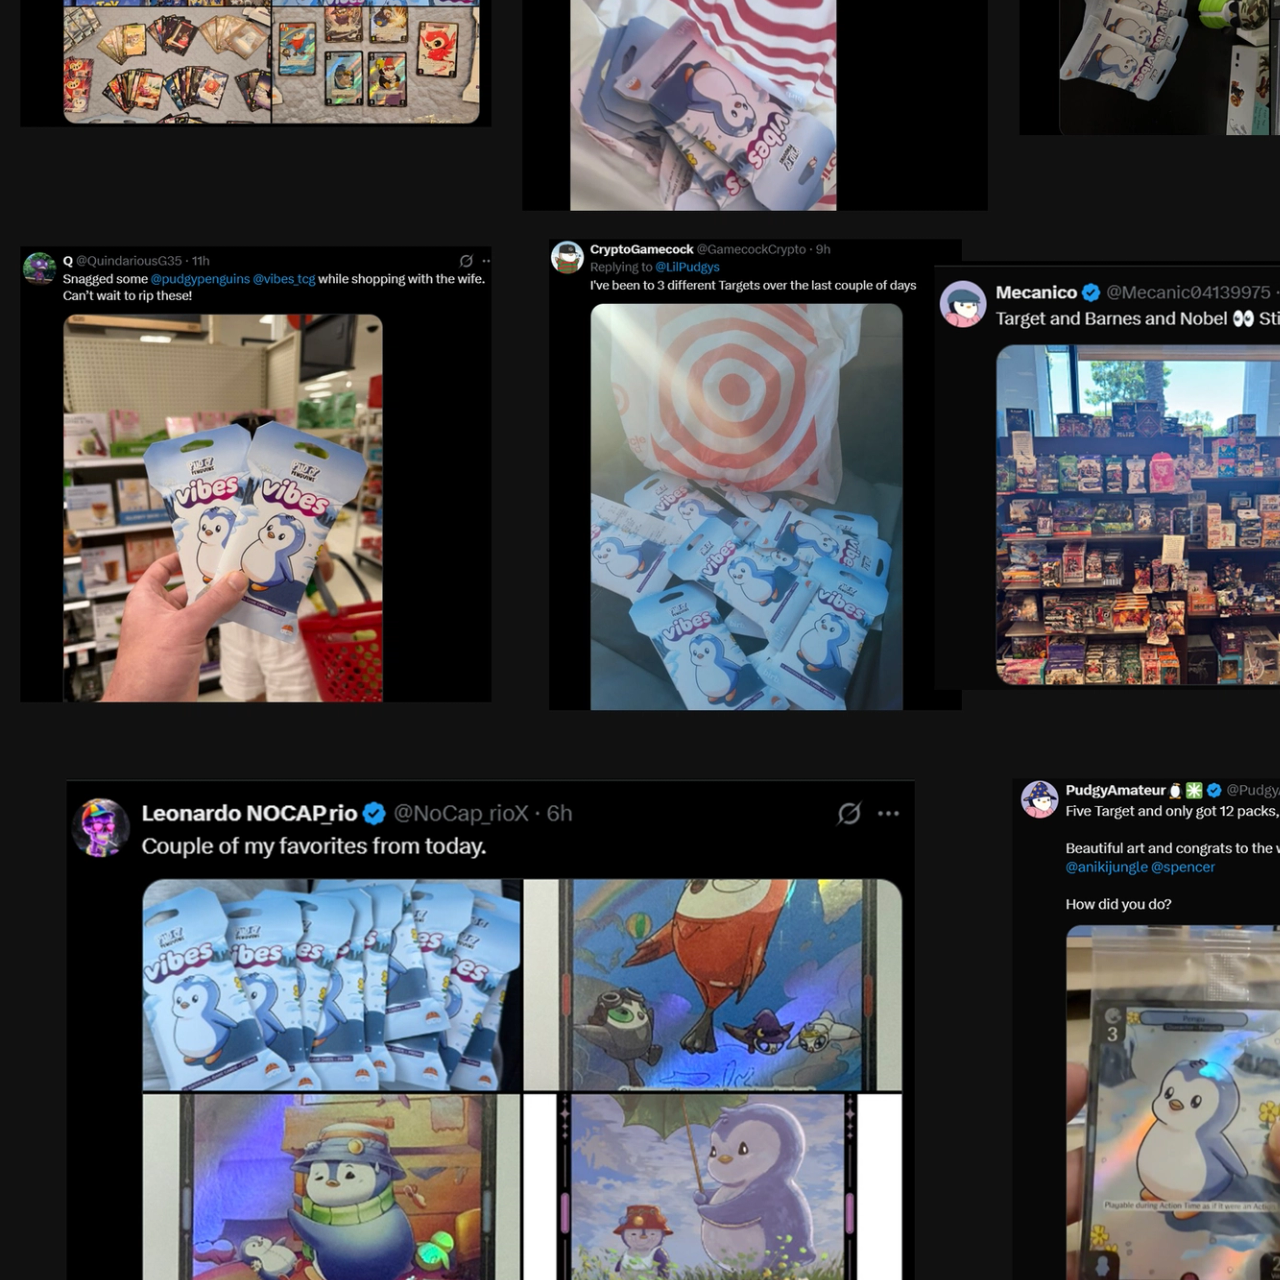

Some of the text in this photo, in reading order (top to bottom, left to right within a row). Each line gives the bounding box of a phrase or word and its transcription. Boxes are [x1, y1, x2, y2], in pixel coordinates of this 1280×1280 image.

[590, 244, 693, 256] CryptoGamecock
[997, 285, 1077, 299] Mecanico
[1067, 784, 1166, 798] PudgyAmateur
[143, 804, 358, 825] Leonardo NOCAP_rio
[142, 837, 486, 859] Couple of my favorites from today.
